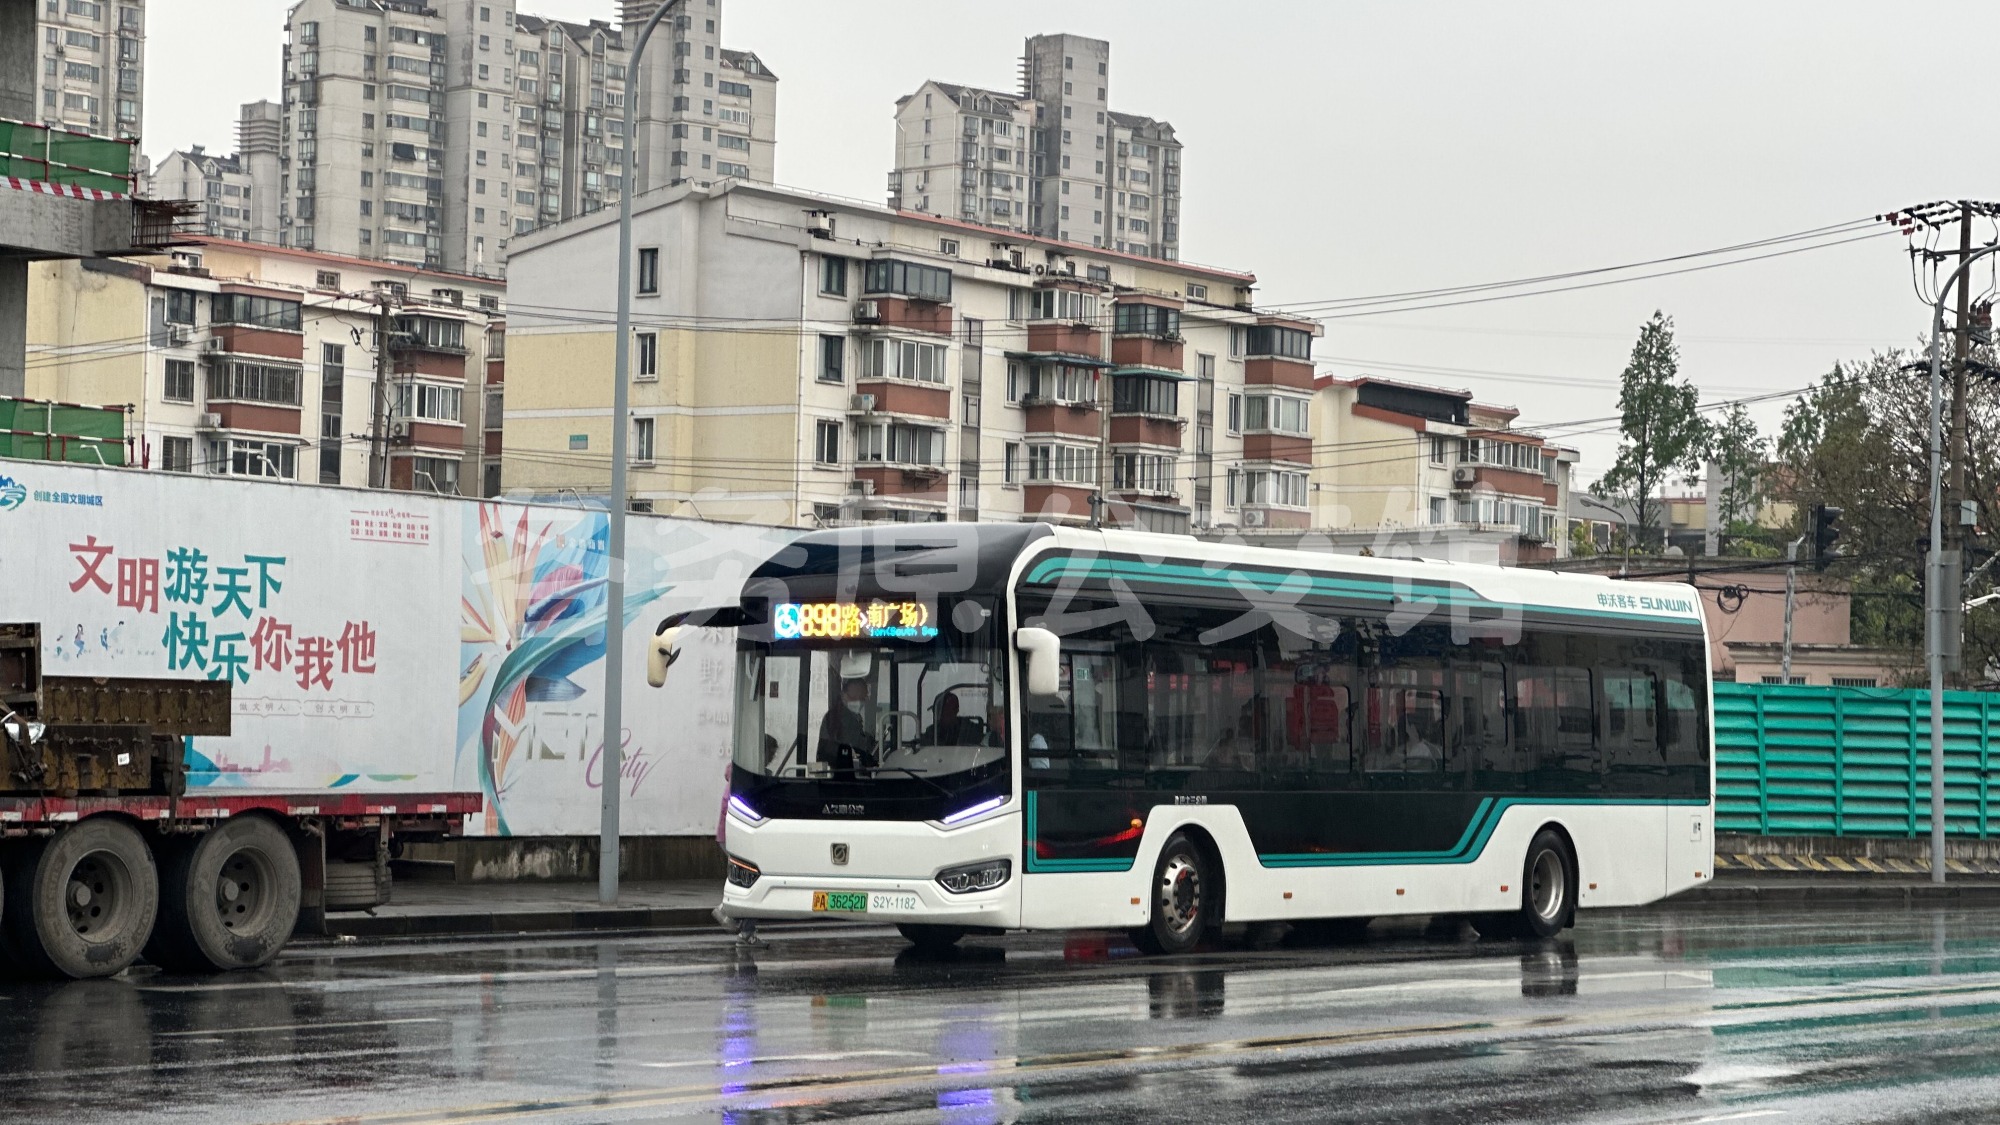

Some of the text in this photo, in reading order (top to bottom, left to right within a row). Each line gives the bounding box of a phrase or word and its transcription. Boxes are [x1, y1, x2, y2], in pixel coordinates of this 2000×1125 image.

[33, 490, 103, 507] 创建全国文明城区
[68, 535, 287, 621] 文明游天下
[1597, 592, 1694, 613] 申沃客车 SUNWIN
[799, 602, 861, 637] 898路
[162, 611, 377, 692] 快乐你我他
[873, 895, 916, 910] S2Y-1182
